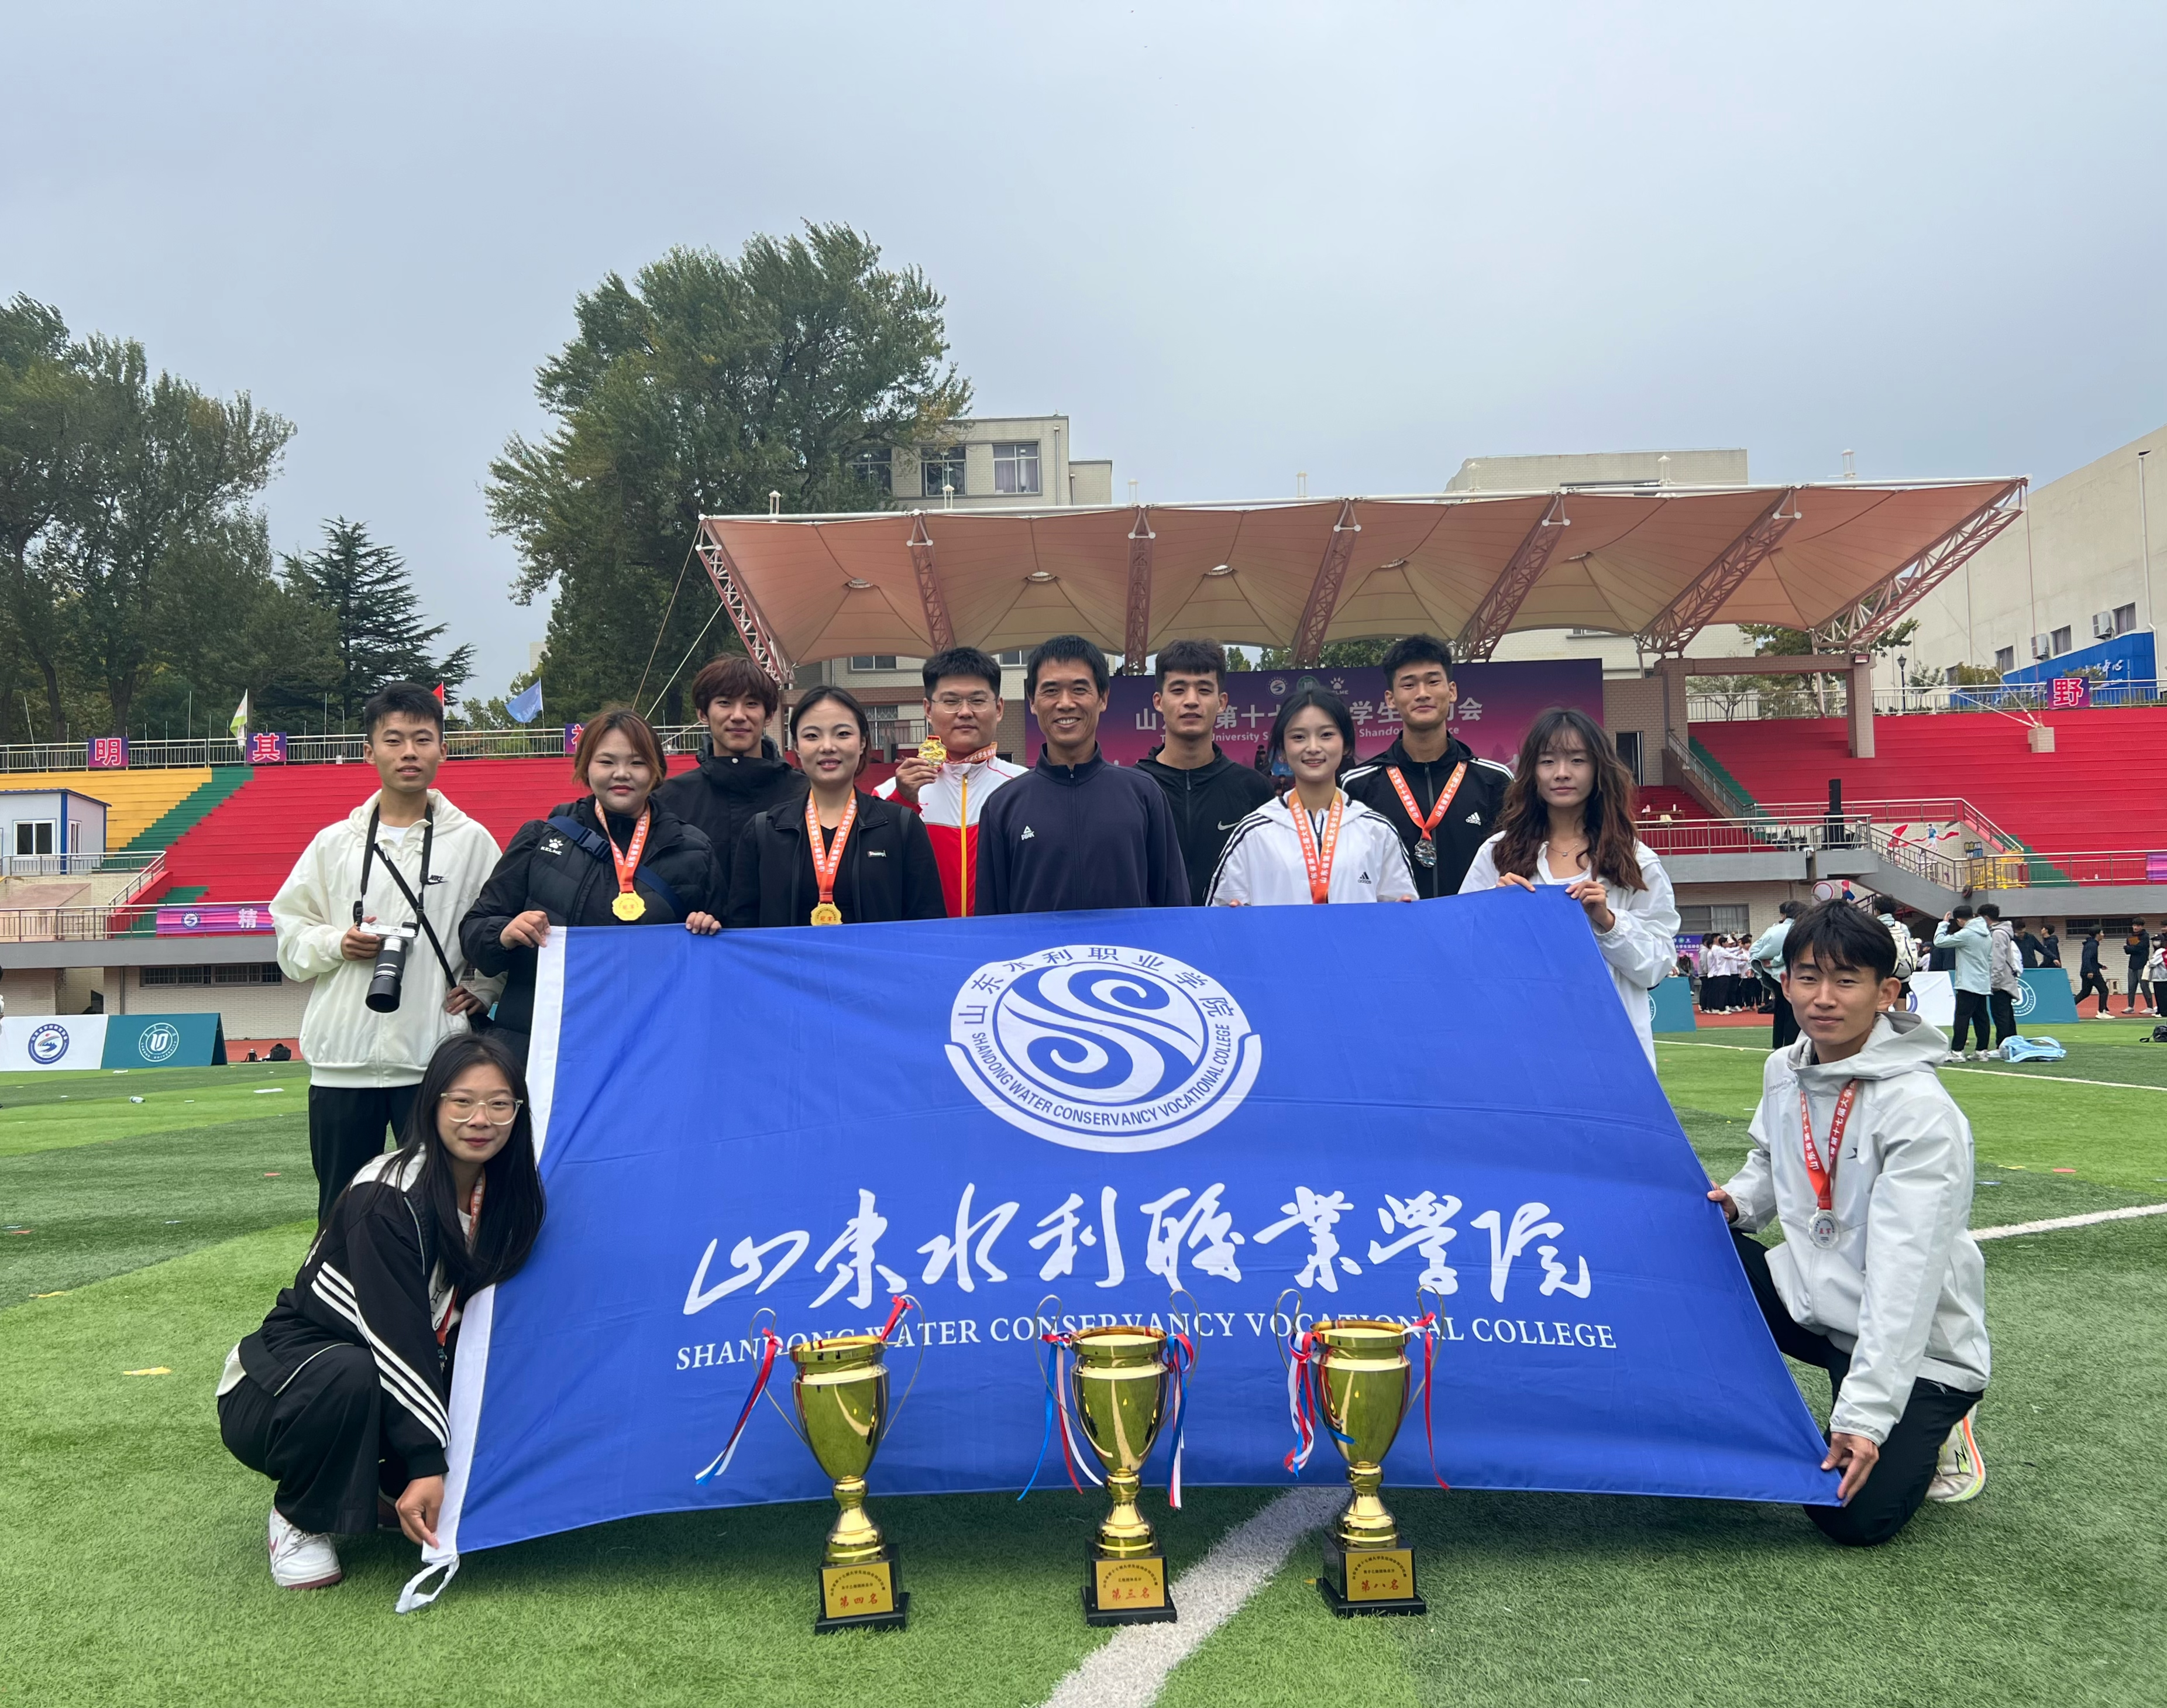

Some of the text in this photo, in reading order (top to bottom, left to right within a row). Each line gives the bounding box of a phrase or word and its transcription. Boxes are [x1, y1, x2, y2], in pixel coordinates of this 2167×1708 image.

[2053, 678, 2085, 706] 野
[1359, 727, 1404, 738] Shando
[94, 738, 122, 766] 明
[252, 733, 280, 762] 其
[1021, 831, 1035, 841] PEAK
[540, 846, 562, 855] KELME
[238, 908, 258, 929] 精
[958, 946, 1236, 1025] 山东水利职业学院
[972, 1023, 1232, 1126] SHANDONG WATER CONSERVANCY VOCATIONAL COLLEGE
[1471, 1318, 1617, 1349] COLLEGE
[1112, 1586, 1150, 1602] 第三名
[1361, 1578, 1399, 1593] 第八名
[840, 1592, 878, 1609] 第四名
